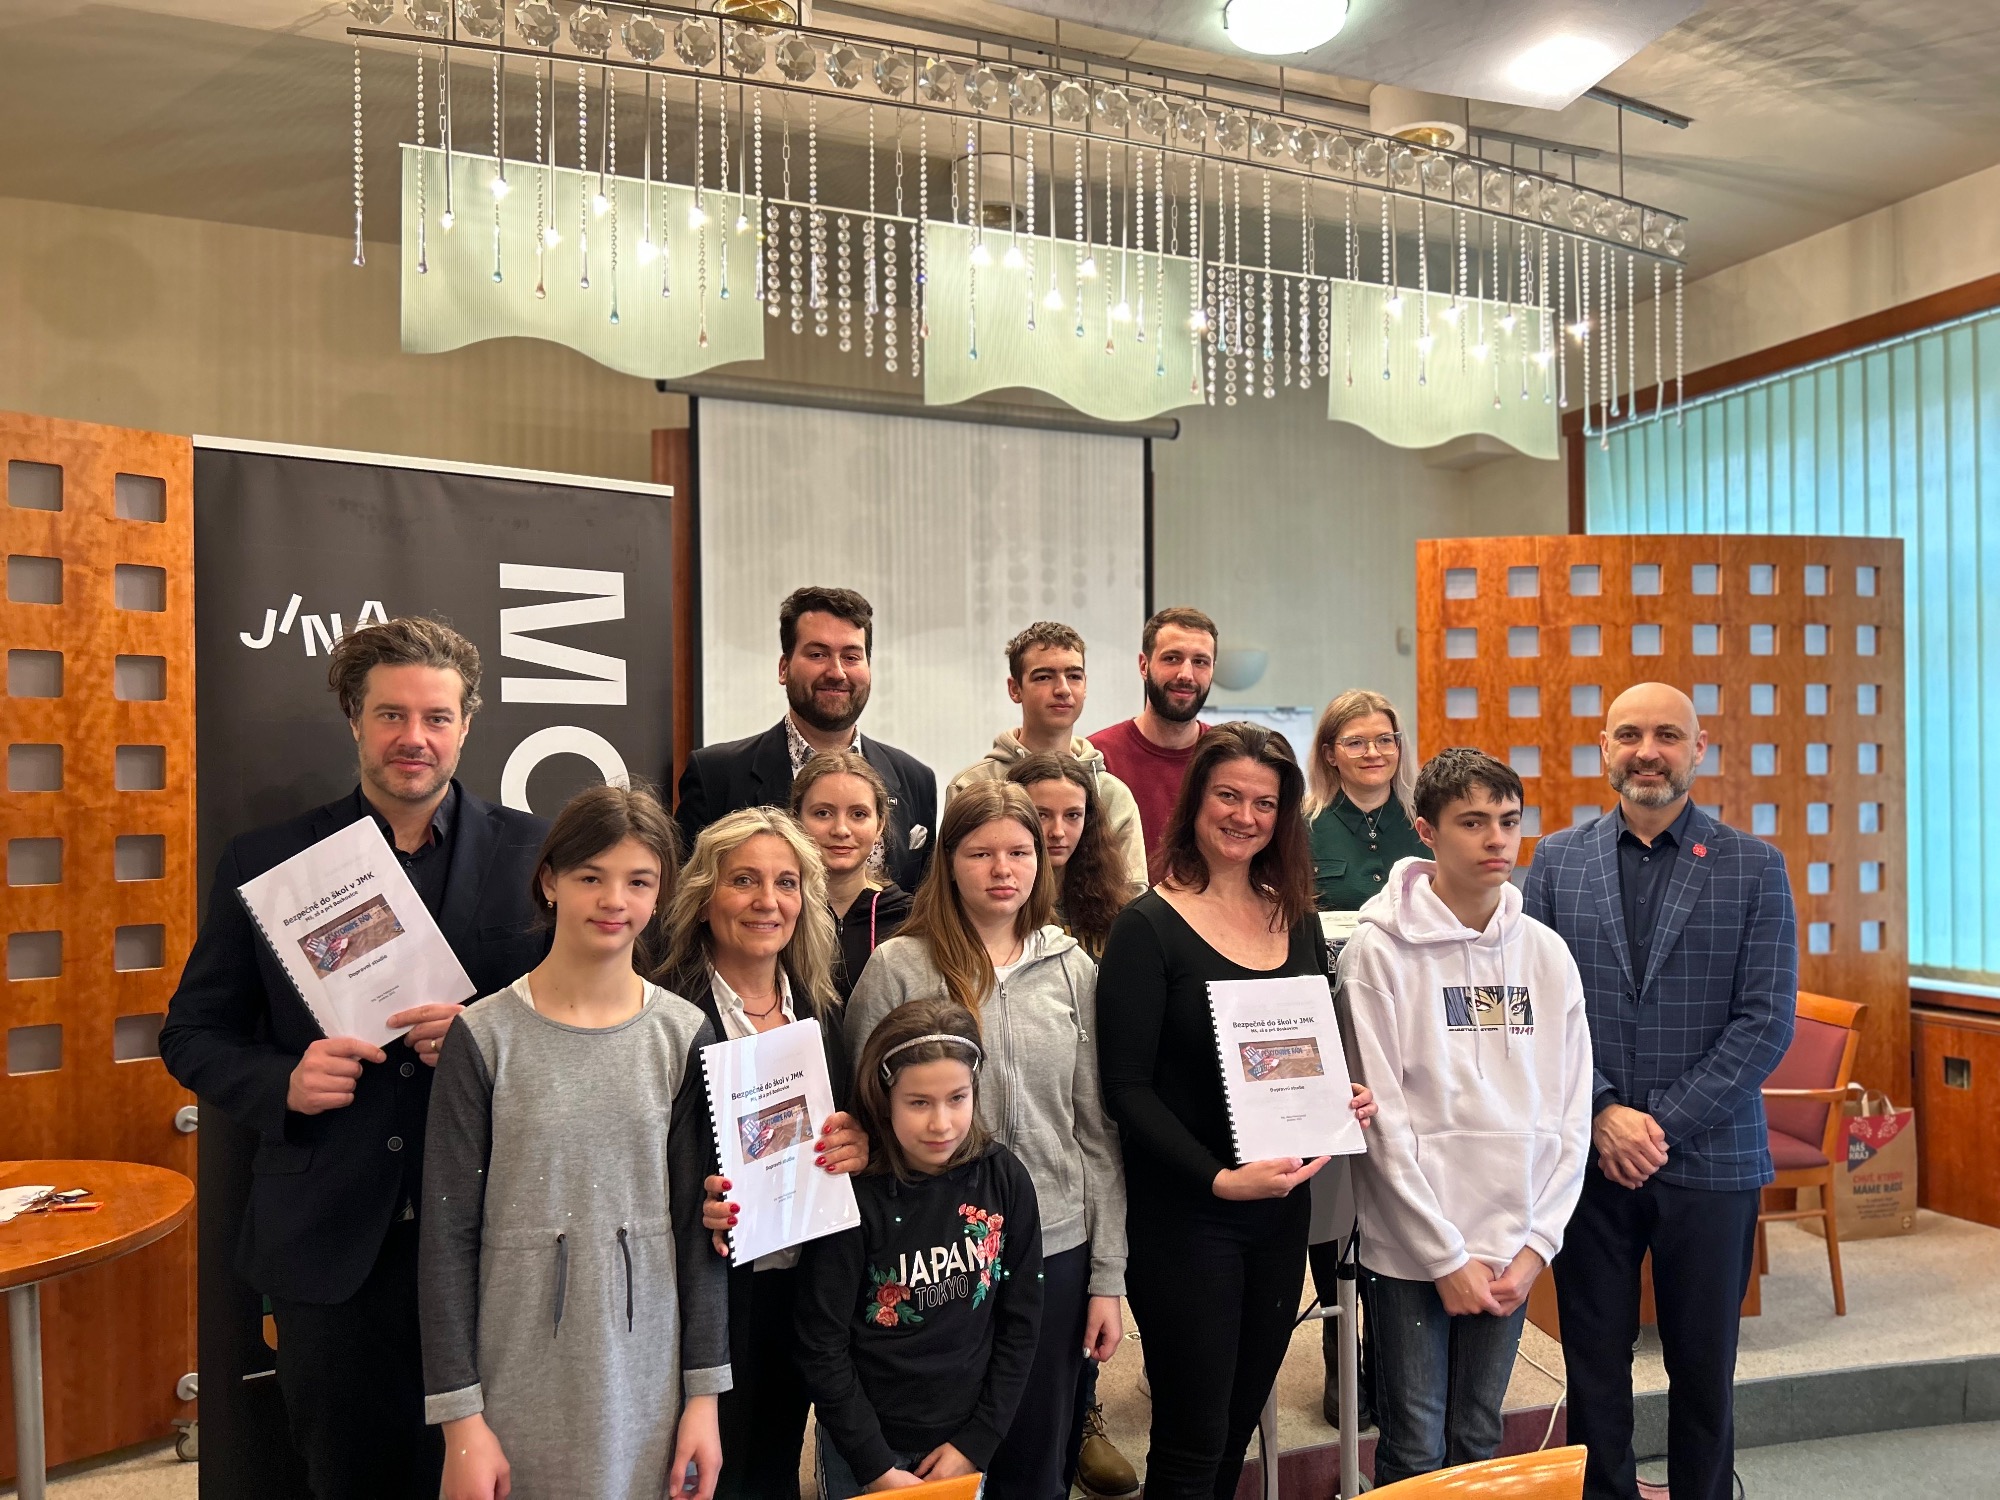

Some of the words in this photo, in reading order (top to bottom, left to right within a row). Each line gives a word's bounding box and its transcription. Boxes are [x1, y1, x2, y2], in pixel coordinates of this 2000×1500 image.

[283, 902, 319, 927] Bezpečně
[320, 896, 331, 906] do
[331, 885, 349, 900] škol
[355, 871, 375, 886] JMK
[1232, 1019, 1266, 1029] Bezpečně
[1277, 1018, 1292, 1026] škol
[764, 1081, 773, 1090] do
[773, 1076, 785, 1087] škol
[790, 1070, 804, 1081] JMK
[897, 1236, 986, 1288] JAPAN
[914, 1273, 969, 1311] TOKYO
